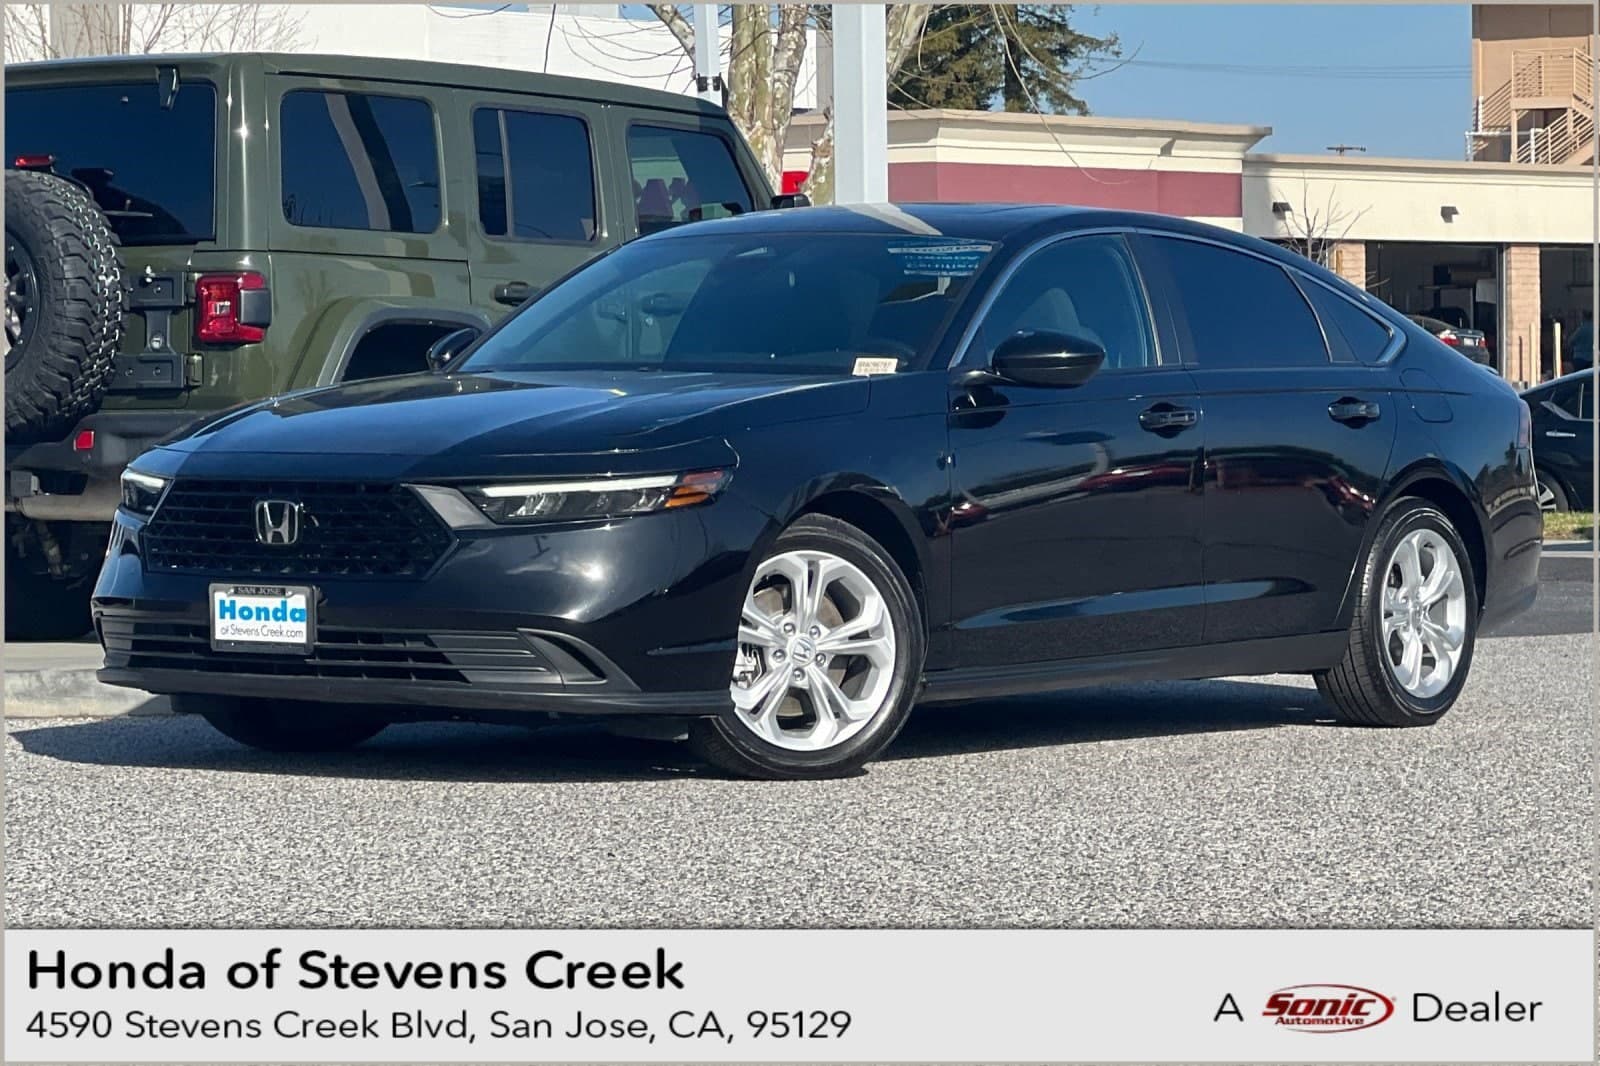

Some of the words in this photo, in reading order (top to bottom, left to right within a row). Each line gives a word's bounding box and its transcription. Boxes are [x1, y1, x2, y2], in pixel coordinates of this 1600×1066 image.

[259, 587, 281, 595] JOSE
[218, 599, 307, 622] Honda
[220, 626, 230, 636] of
[230, 623, 260, 636] Stevens
[261, 624, 304, 638] Creek.com
